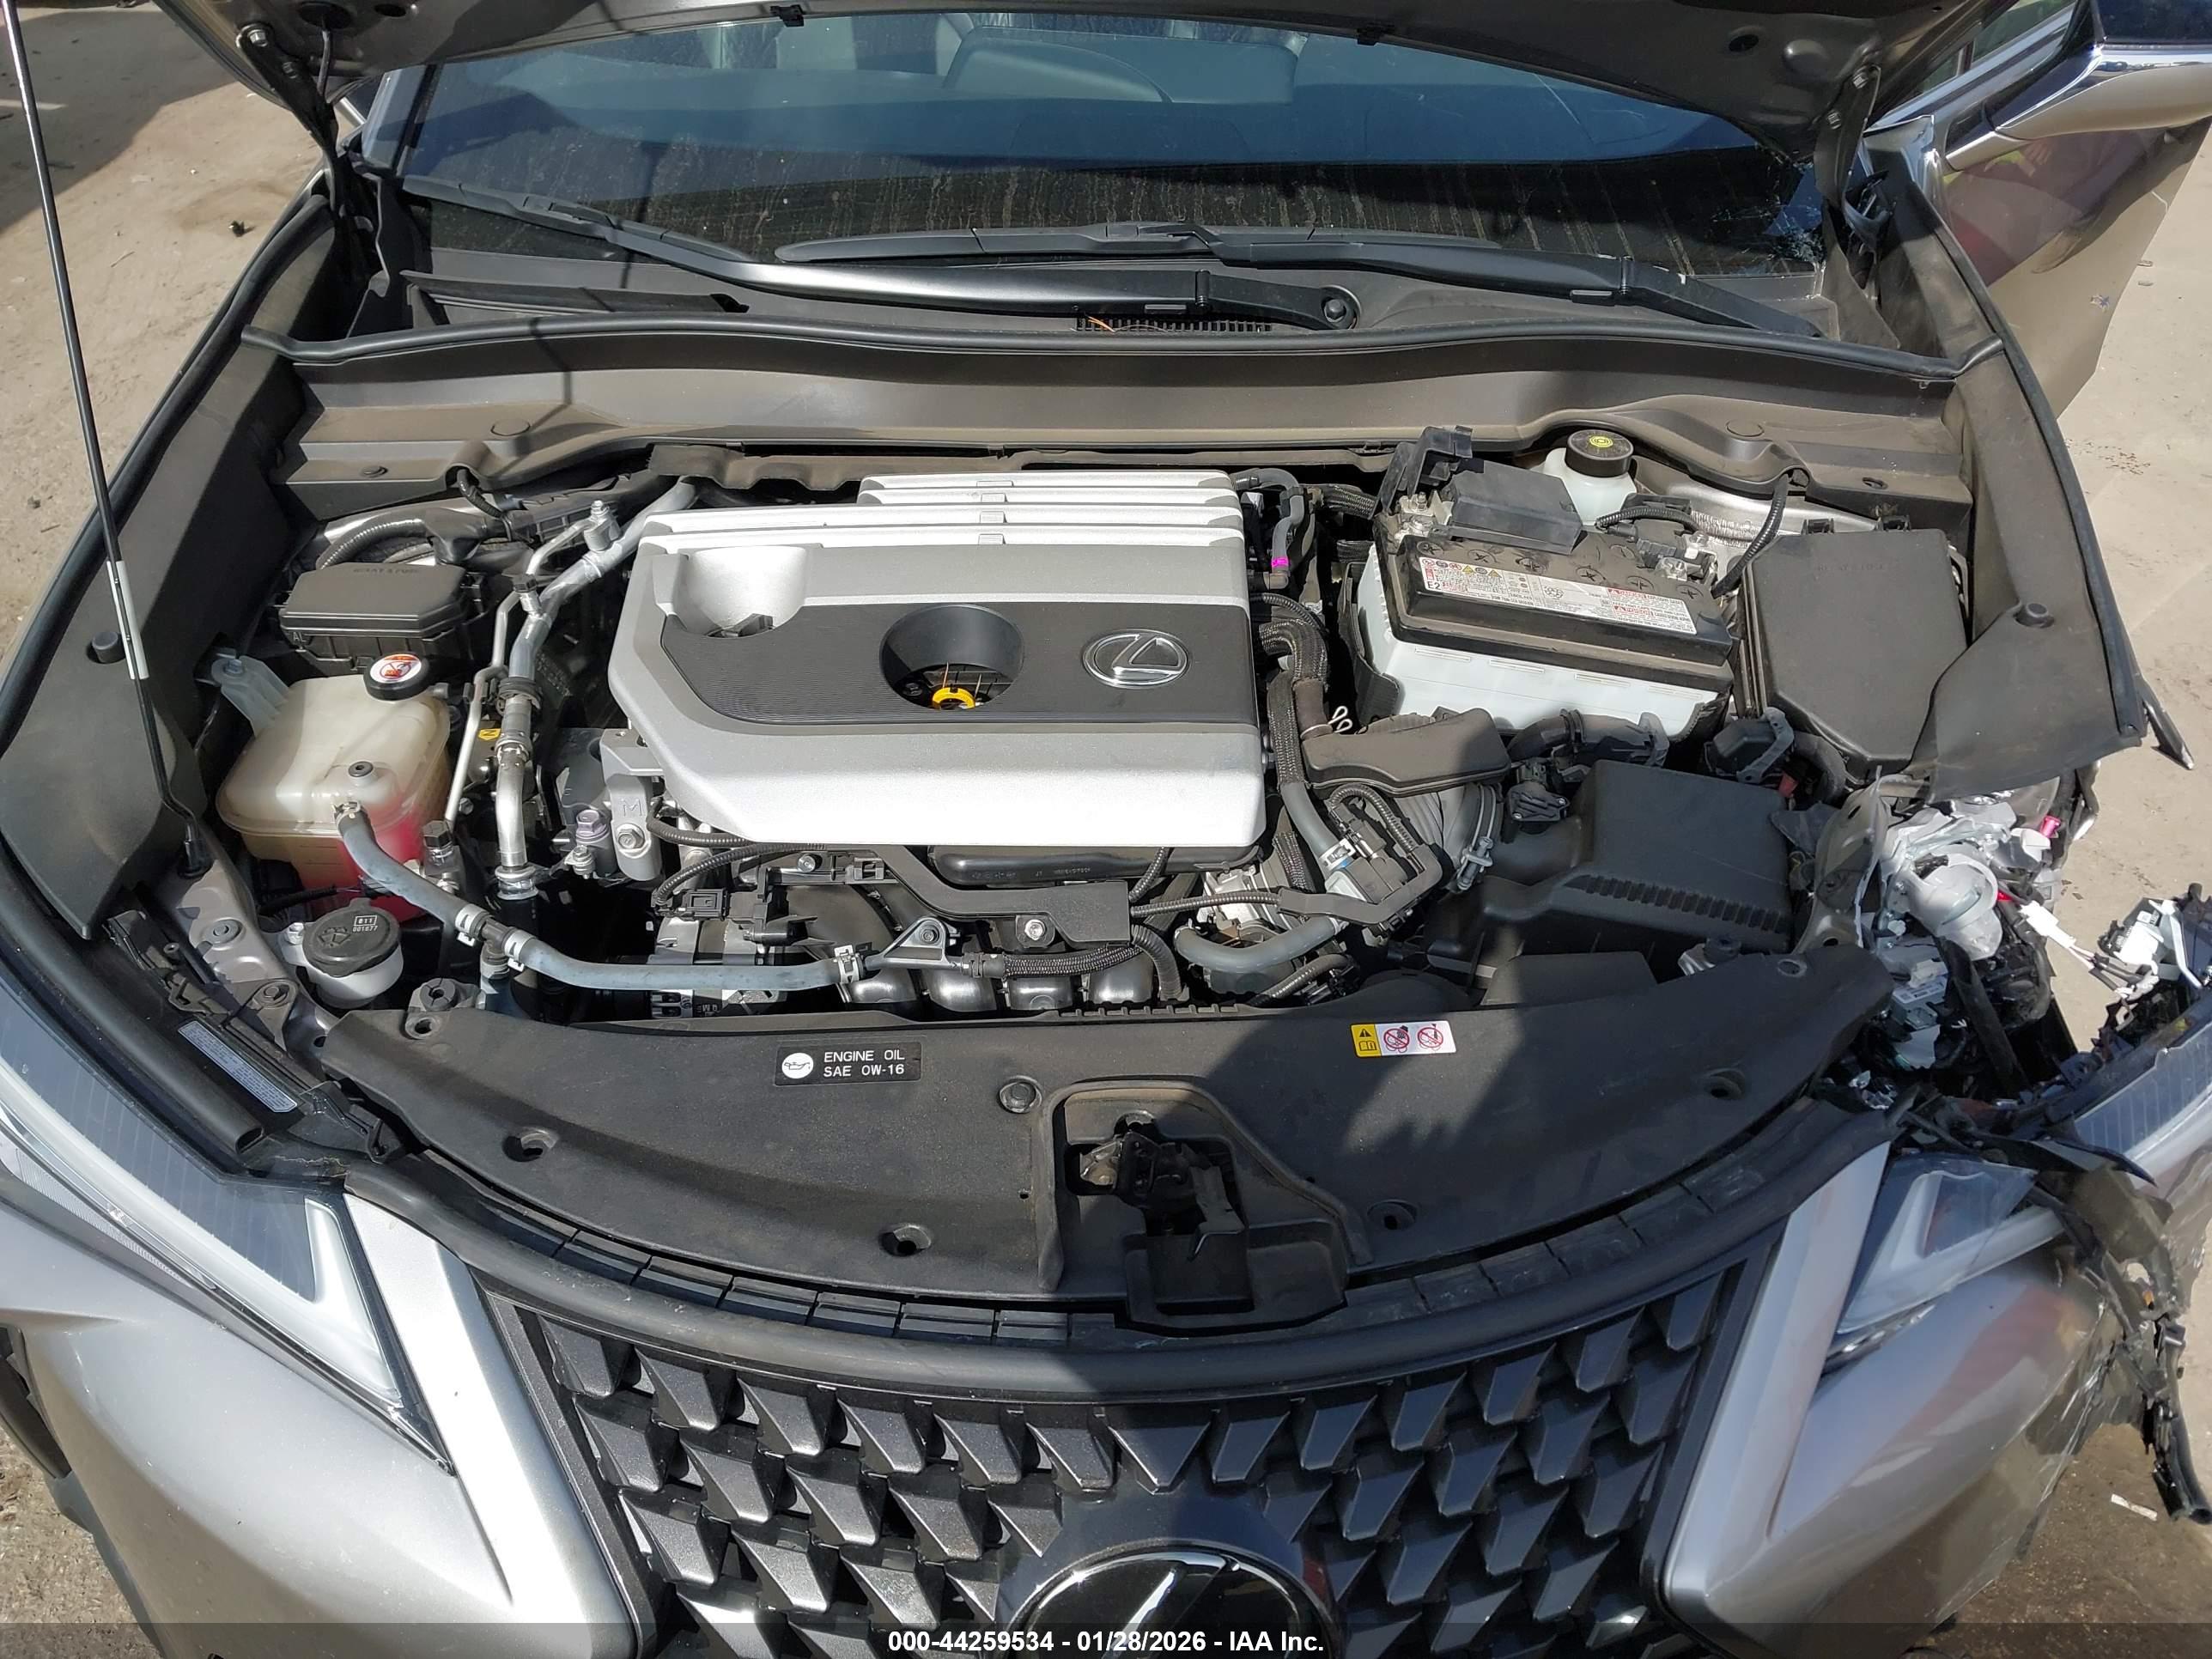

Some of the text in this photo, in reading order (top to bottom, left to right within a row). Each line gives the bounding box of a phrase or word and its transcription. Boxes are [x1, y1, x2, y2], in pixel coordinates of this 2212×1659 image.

[823, 1049, 906, 1063] ENGINE OIL
[823, 1063, 905, 1078] SAE 0W-16
